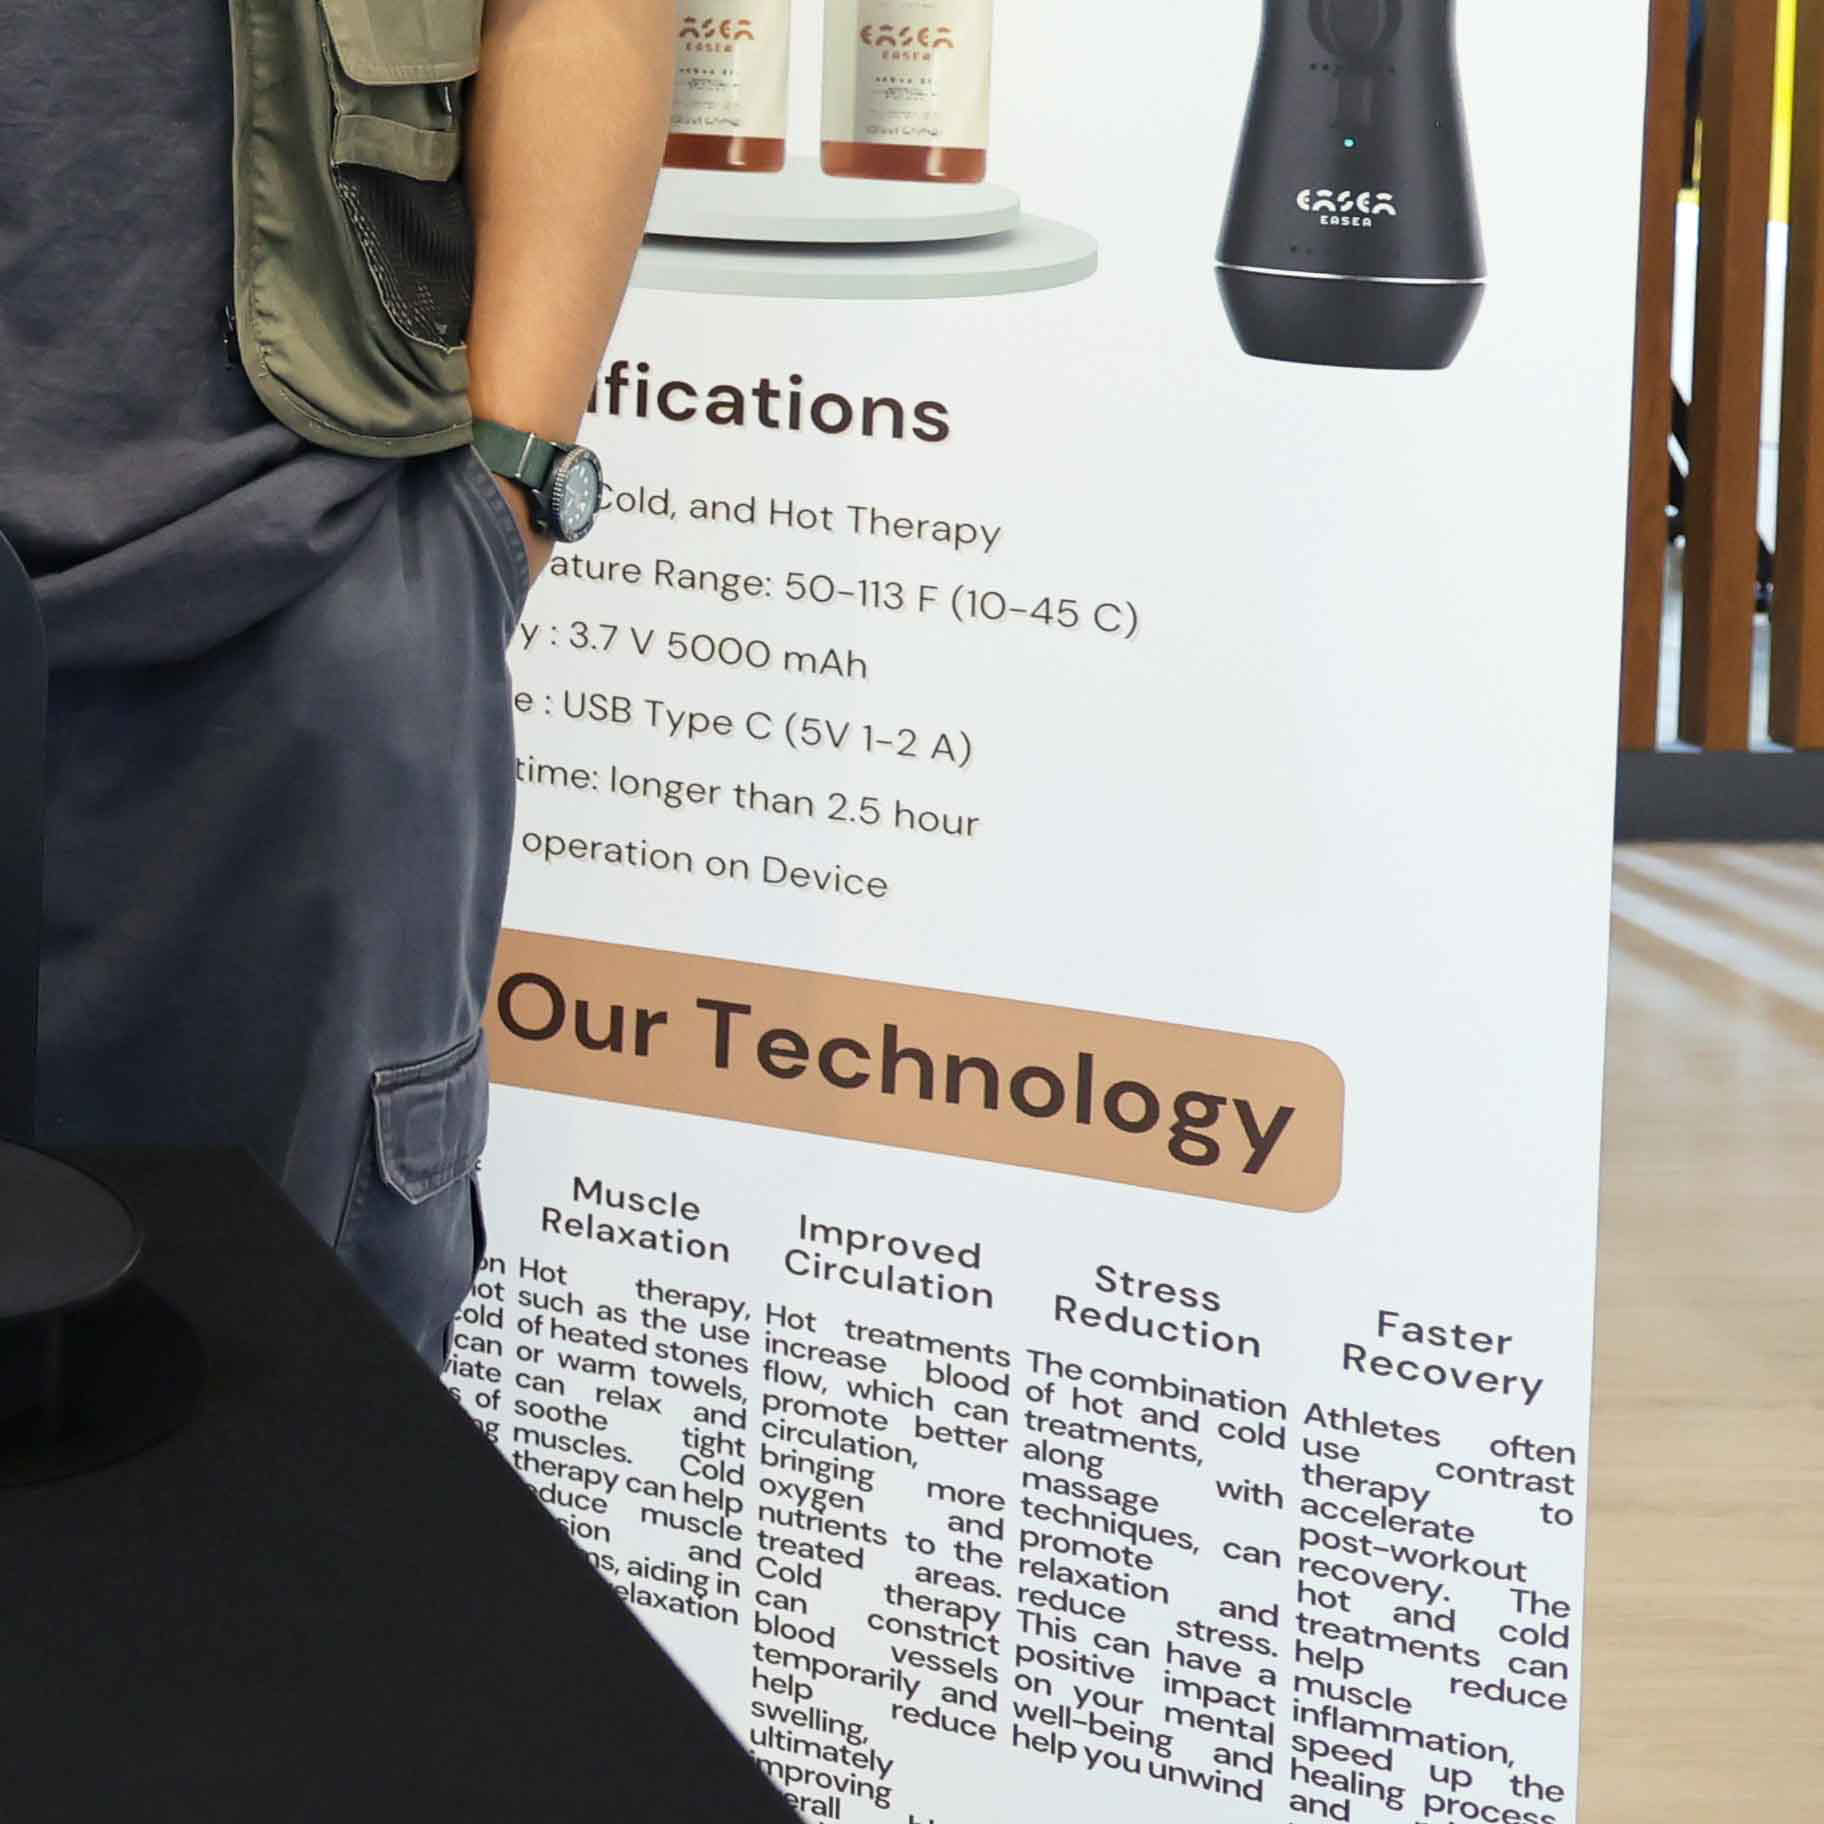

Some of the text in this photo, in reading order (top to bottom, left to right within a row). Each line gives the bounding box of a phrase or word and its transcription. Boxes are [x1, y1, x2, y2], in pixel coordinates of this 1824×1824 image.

[1320, 215, 1372, 227] EASEA
[588, 360, 950, 443] fications
[689, 495, 756, 524] and
[770, 498, 833, 531] Hot
[847, 505, 1001, 553] Therapy
[550, 554, 642, 584] ature
[655, 559, 771, 602] Range:
[919, 585, 938, 612] F
[1094, 601, 1138, 639] C)
[569, 620, 618, 651] 3.7
[630, 627, 655, 655] V
[668, 631, 771, 668] 5000
[784, 648, 867, 679] mAh
[564, 690, 631, 724] USB
[645, 699, 733, 739] Type
[746, 711, 771, 740] C
[785, 712, 850, 749] (5V
[863, 724, 916, 757] 1-2
[931, 731, 971, 768] A)
[611, 765, 721, 809] longer
[733, 781, 813, 817] than
[828, 792, 880, 825] 2.5
[895, 799, 979, 836] hour
[522, 832, 888, 898] operation on Device
[496, 971, 1296, 1175] Our Technology
[573, 1175, 700, 1222] Muscle
[541, 1206, 729, 1263] Relaxation
[799, 1213, 981, 1270] Improved
[519, 1256, 751, 1323] Hot therapy,
[784, 1248, 993, 1309] Circulation
[1095, 1264, 1221, 1312] Stress
[516, 1314, 749, 1374] of heated stones
[517, 1289, 751, 1346] such as the use
[766, 1302, 1011, 1368] Hot treatments
[1055, 1294, 1260, 1358] Reduction
[1377, 1309, 1513, 1355] Faster
[516, 1344, 748, 1406] or warm towels,
[762, 1358, 1009, 1426] flow, which can
[765, 1329, 1010, 1397] increase blood
[1026, 1348, 1287, 1421] The combination
[1343, 1342, 1544, 1406] Recovery
[513, 1399, 746, 1459] soothe tight
[762, 1393, 1009, 1454] promote better
[1023, 1409, 1203, 1467] treatments,
[1025, 1381, 1286, 1450] of hot and cold
[1303, 1402, 1576, 1465] Athletes often
[1301, 1462, 1574, 1527] therapy to
[1303, 1437, 1575, 1496] use contrast
[758, 1505, 1004, 1569] nutrients to the
[1300, 1497, 1475, 1544] accelerate
[1299, 1527, 1527, 1583] post-workout
[752, 1641, 998, 1713] temporarily and
[1015, 1608, 1277, 1687] This can have a
[1293, 1675, 1413, 1715] muscle
[1012, 1723, 1264, 1803] help you unwind
[1293, 1697, 1515, 1769] inflammation,
